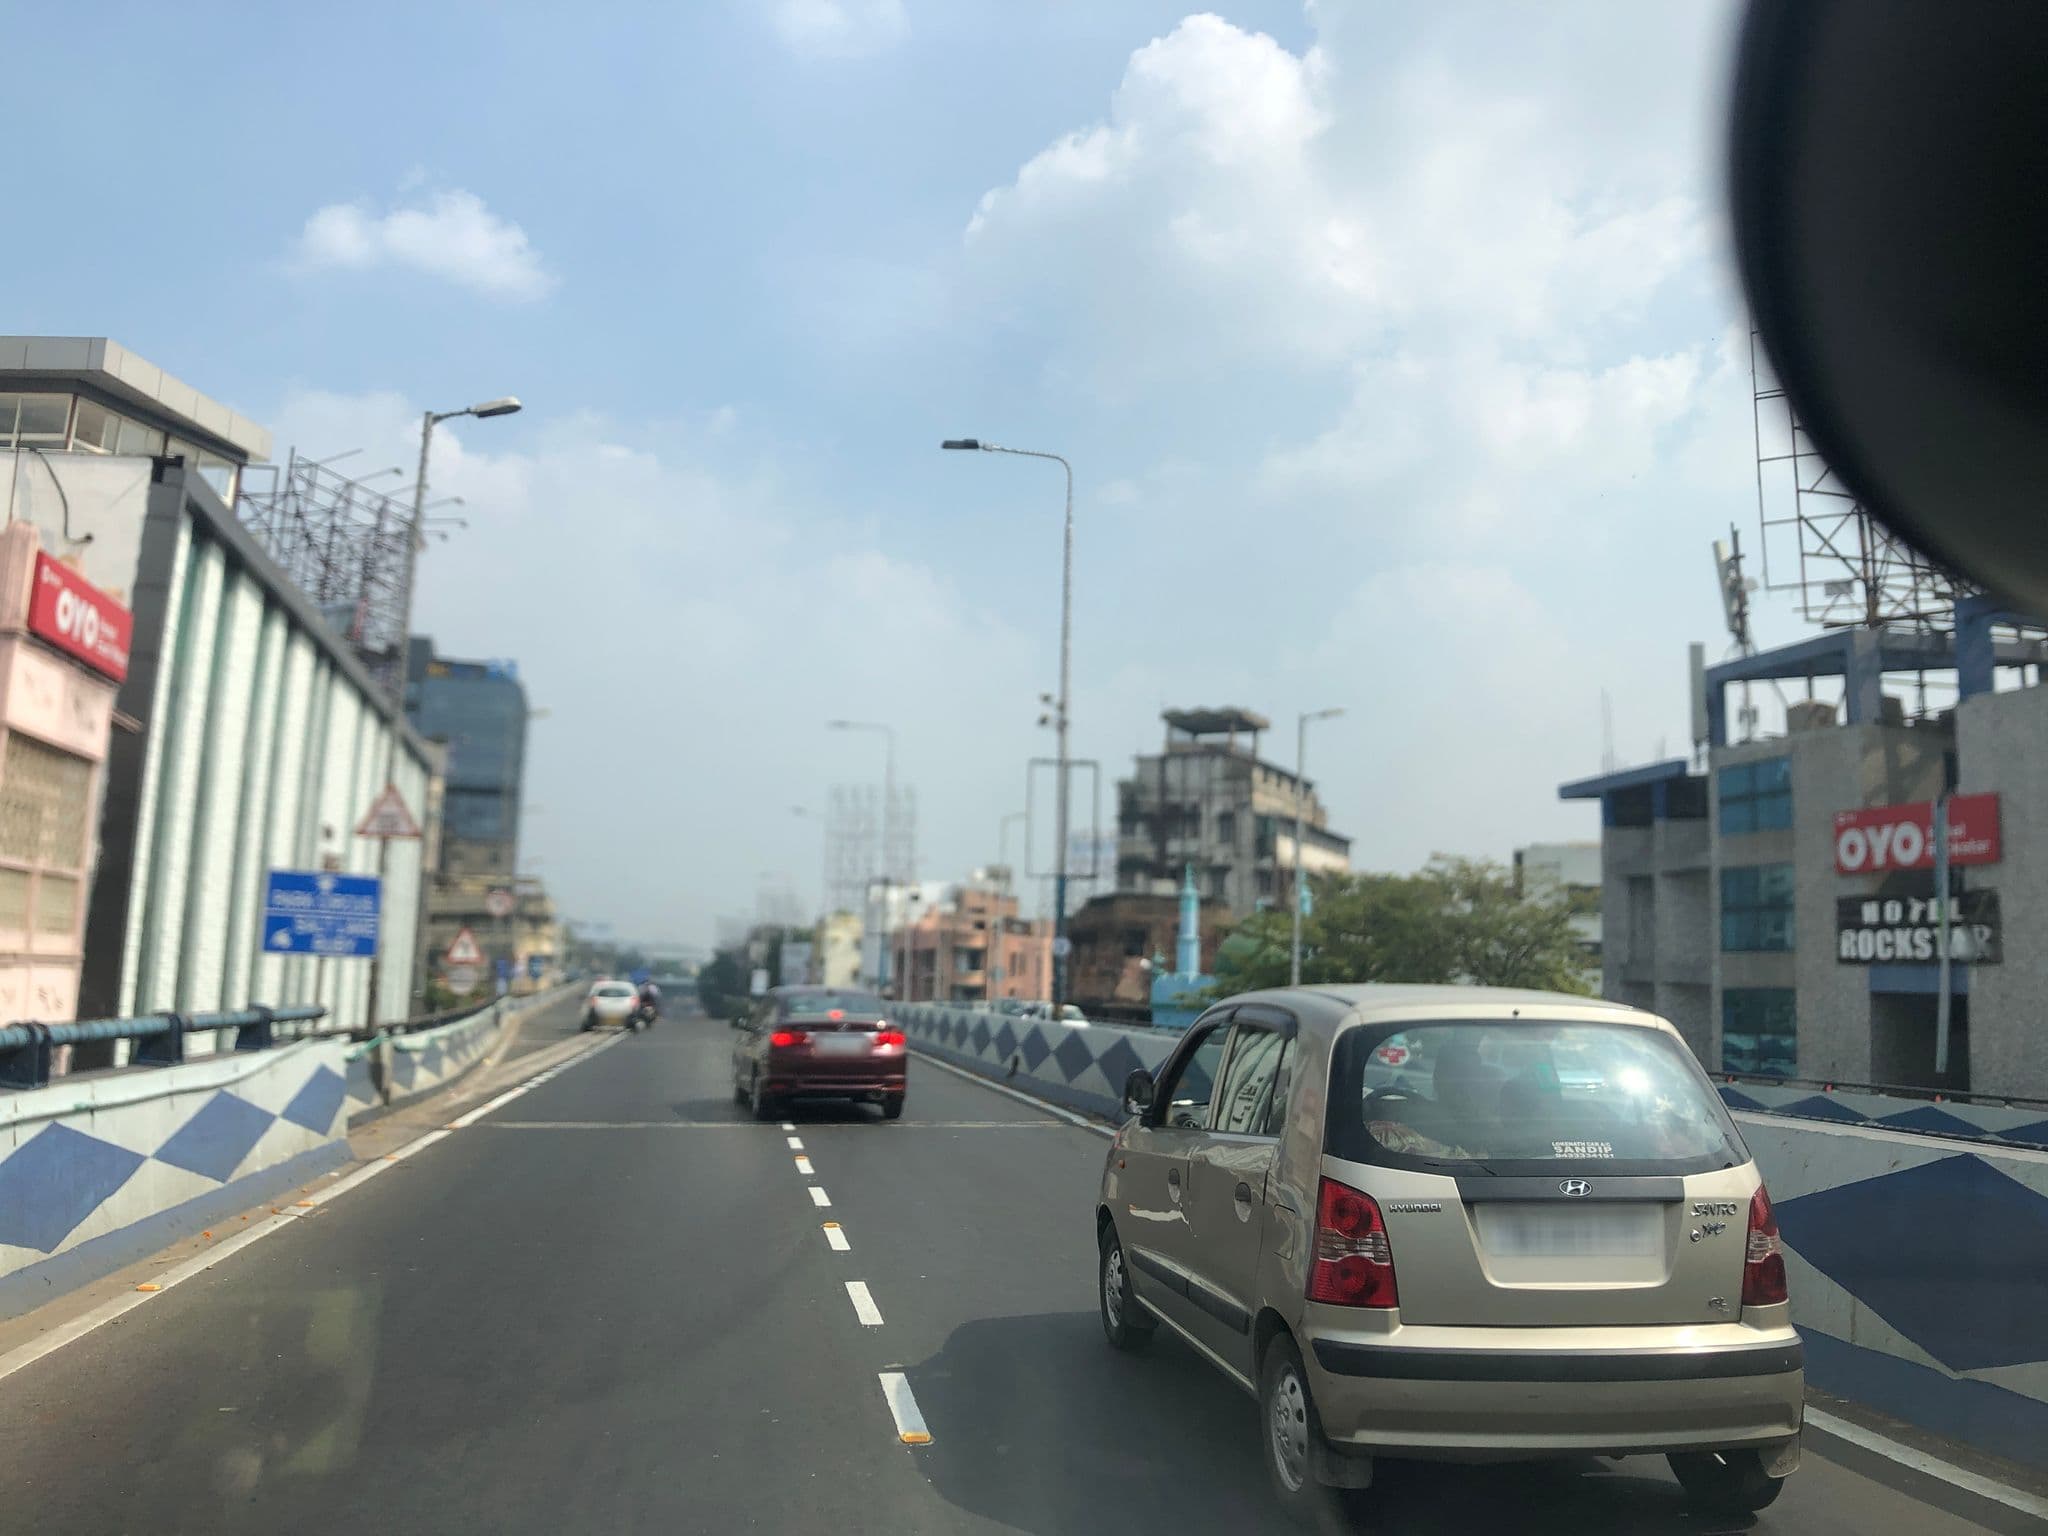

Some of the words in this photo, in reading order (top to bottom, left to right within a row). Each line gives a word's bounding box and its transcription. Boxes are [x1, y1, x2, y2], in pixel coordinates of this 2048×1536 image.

[55, 586, 99, 649] OYO
[1838, 821, 1924, 871] OYO
[1840, 924, 1995, 961] ROCKSTAR
[1554, 1146, 1613, 1154] SANDIP
[1390, 1203, 1442, 1212] HYUNDAI
[1690, 1202, 1738, 1217] SANTRO
